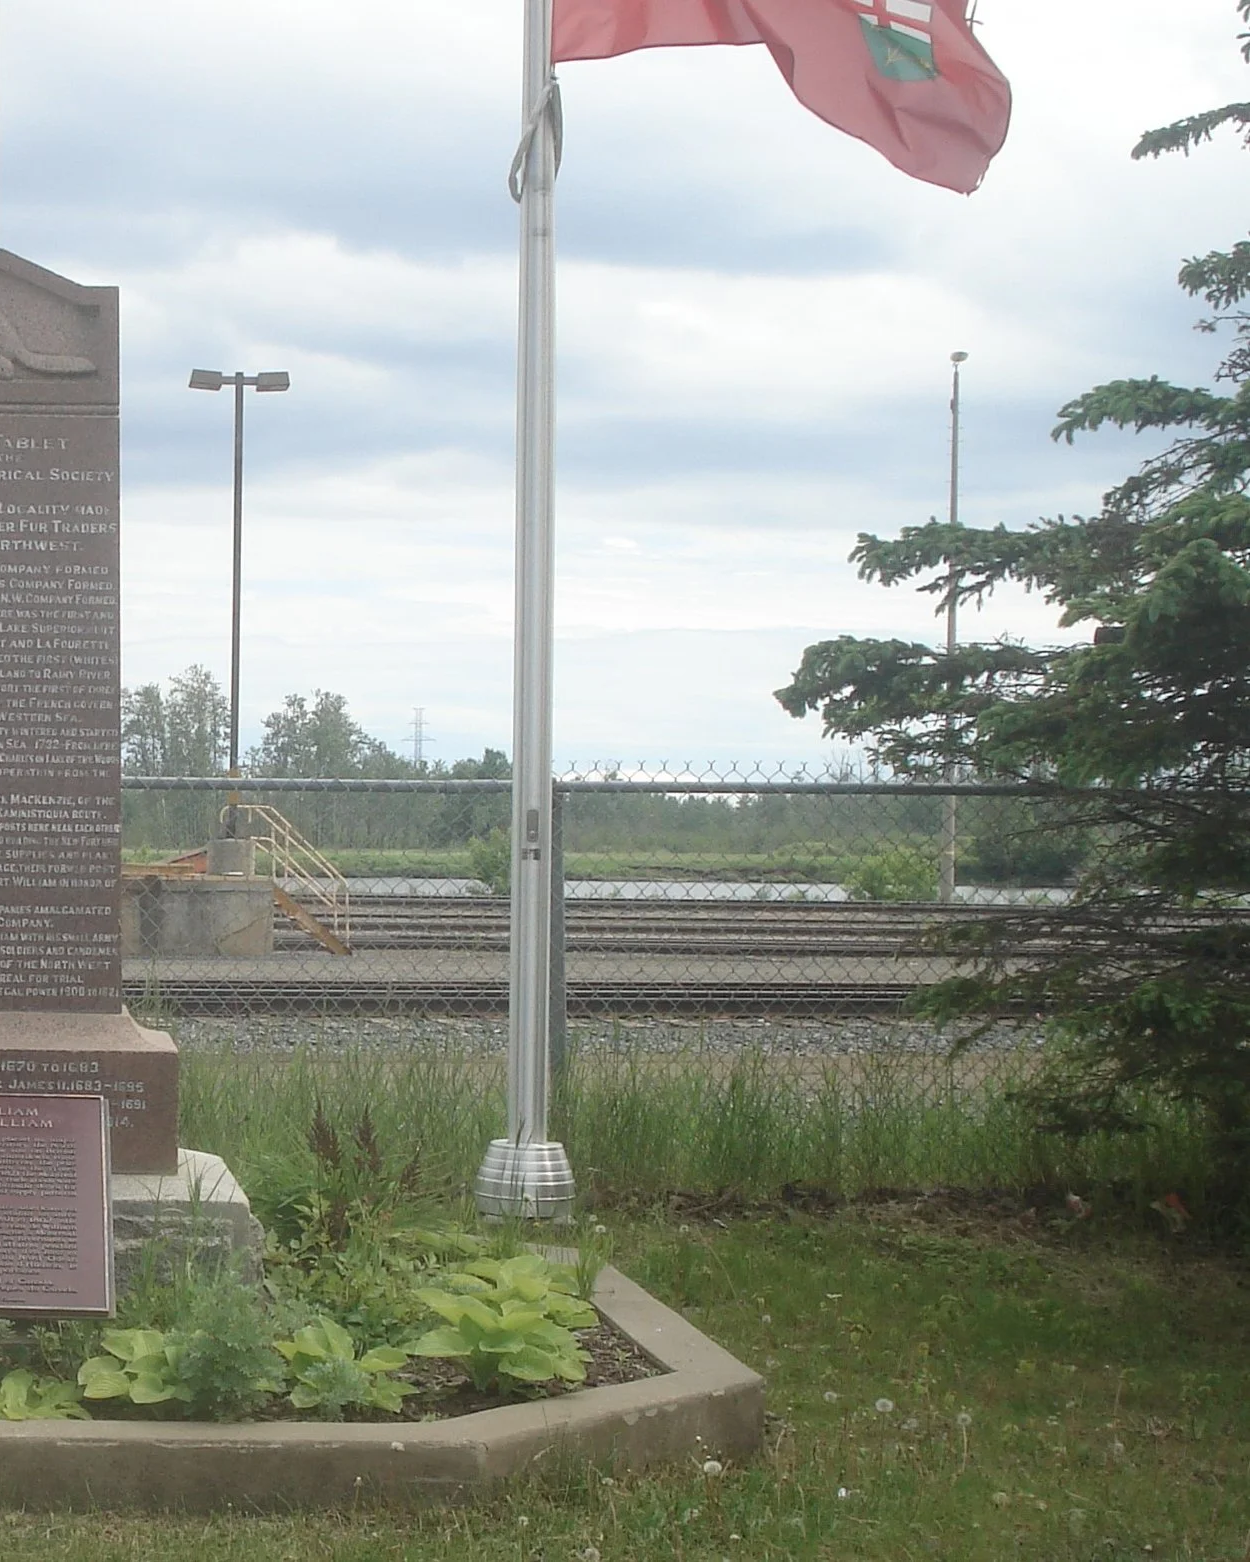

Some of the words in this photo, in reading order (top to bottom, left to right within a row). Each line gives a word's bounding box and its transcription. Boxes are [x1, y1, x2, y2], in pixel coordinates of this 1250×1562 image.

[50, 468, 114, 482] SOCIETY
[20, 519, 47, 533] FUR
[51, 520, 118, 535] TRADERS
[9, 577, 64, 590] COMPANY
[0, 621, 29, 634] LAKE
[10, 639, 33, 650] AND
[0, 668, 26, 679] LAND
[95, 796, 116, 806] THE
[11, 876, 57, 888] WILLIAM
[0, 958, 13, 969] OF
[17, 959, 39, 970] THE
[1, 1060, 36, 1072] 1670
[42, 1063, 59, 1073] TO
[62, 1061, 100, 1074] 1683
[8, 1079, 54, 1091] JAMES
